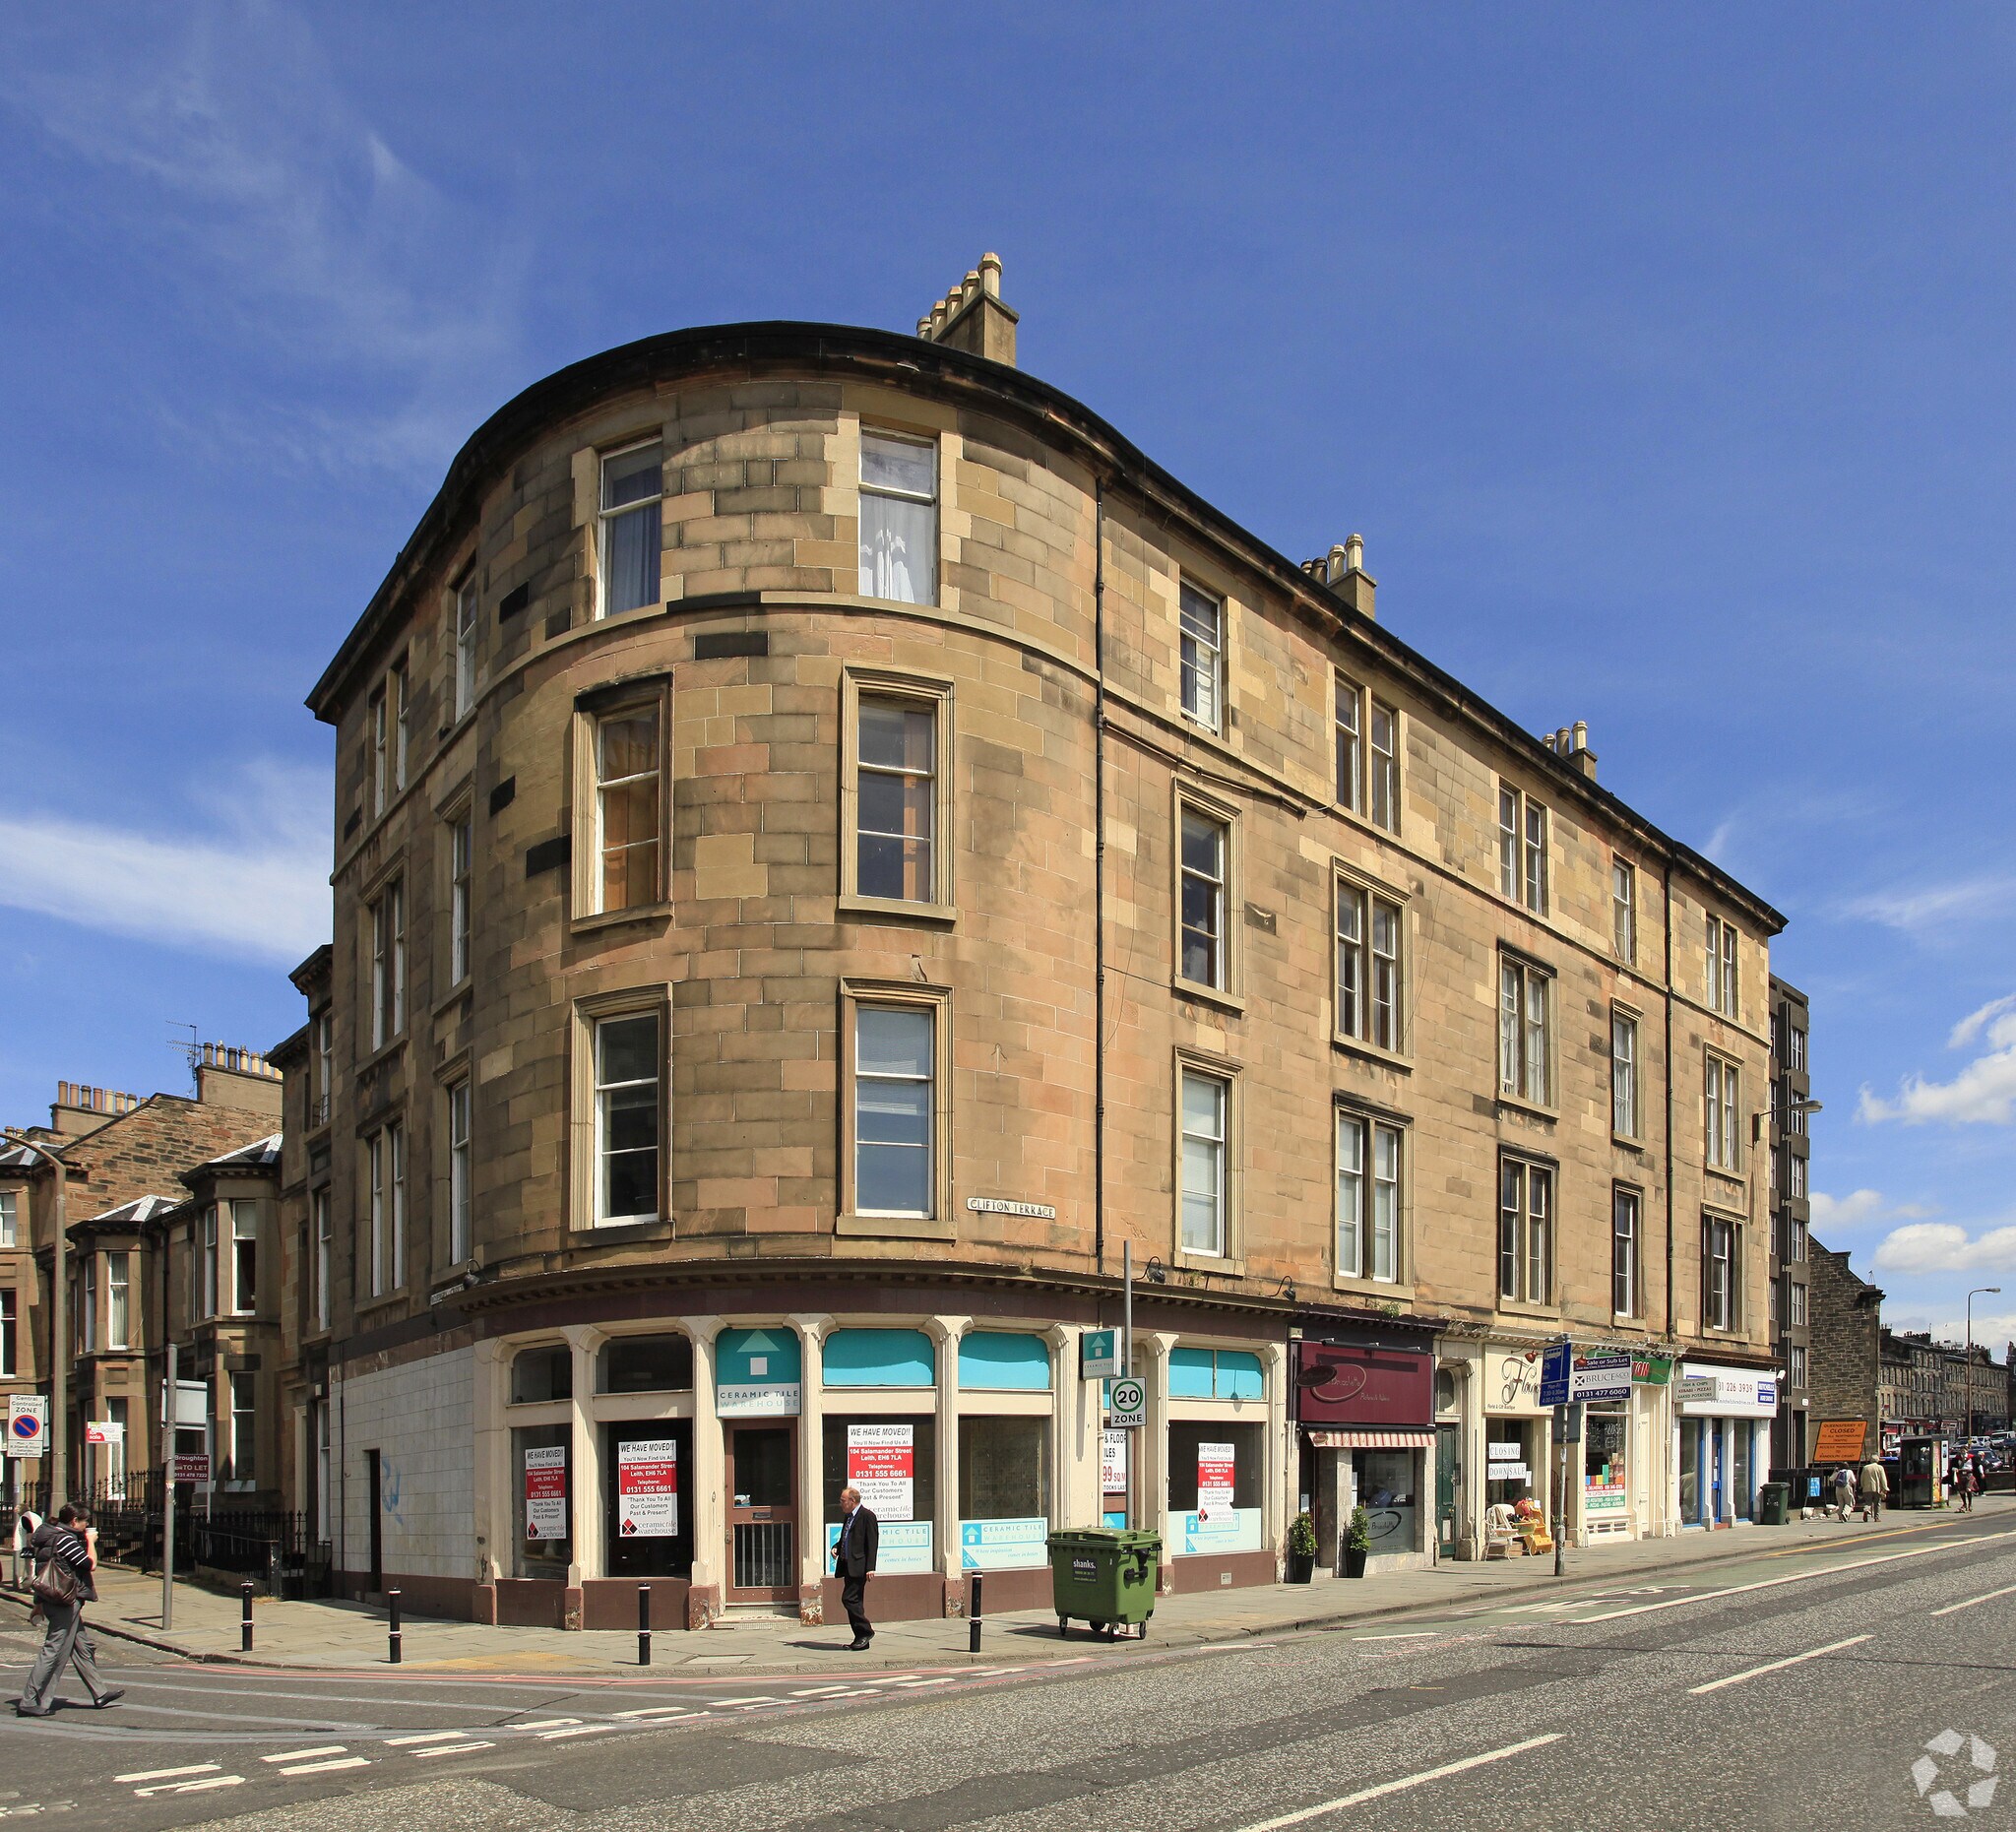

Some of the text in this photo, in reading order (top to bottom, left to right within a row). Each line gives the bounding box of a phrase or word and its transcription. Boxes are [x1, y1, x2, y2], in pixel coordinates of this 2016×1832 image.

[970, 1199, 1053, 1217] CLIFTON TERRACE
[1118, 1390, 1139, 1404] 20
[1114, 1414, 1142, 1423] ZONE
[862, 1427, 881, 1436] HAVE
[882, 1427, 911, 1436] MOVED!!
[1104, 1433, 1108, 1443] &
[621, 1442, 674, 1453] WE HAVE MOVED!!
[1490, 1447, 1520, 1456] CLOSING
[1103, 1448, 1116, 1458] ILES
[1489, 1467, 1525, 1477] DOWN SALE
[1073, 1559, 1097, 1569] shanks.
